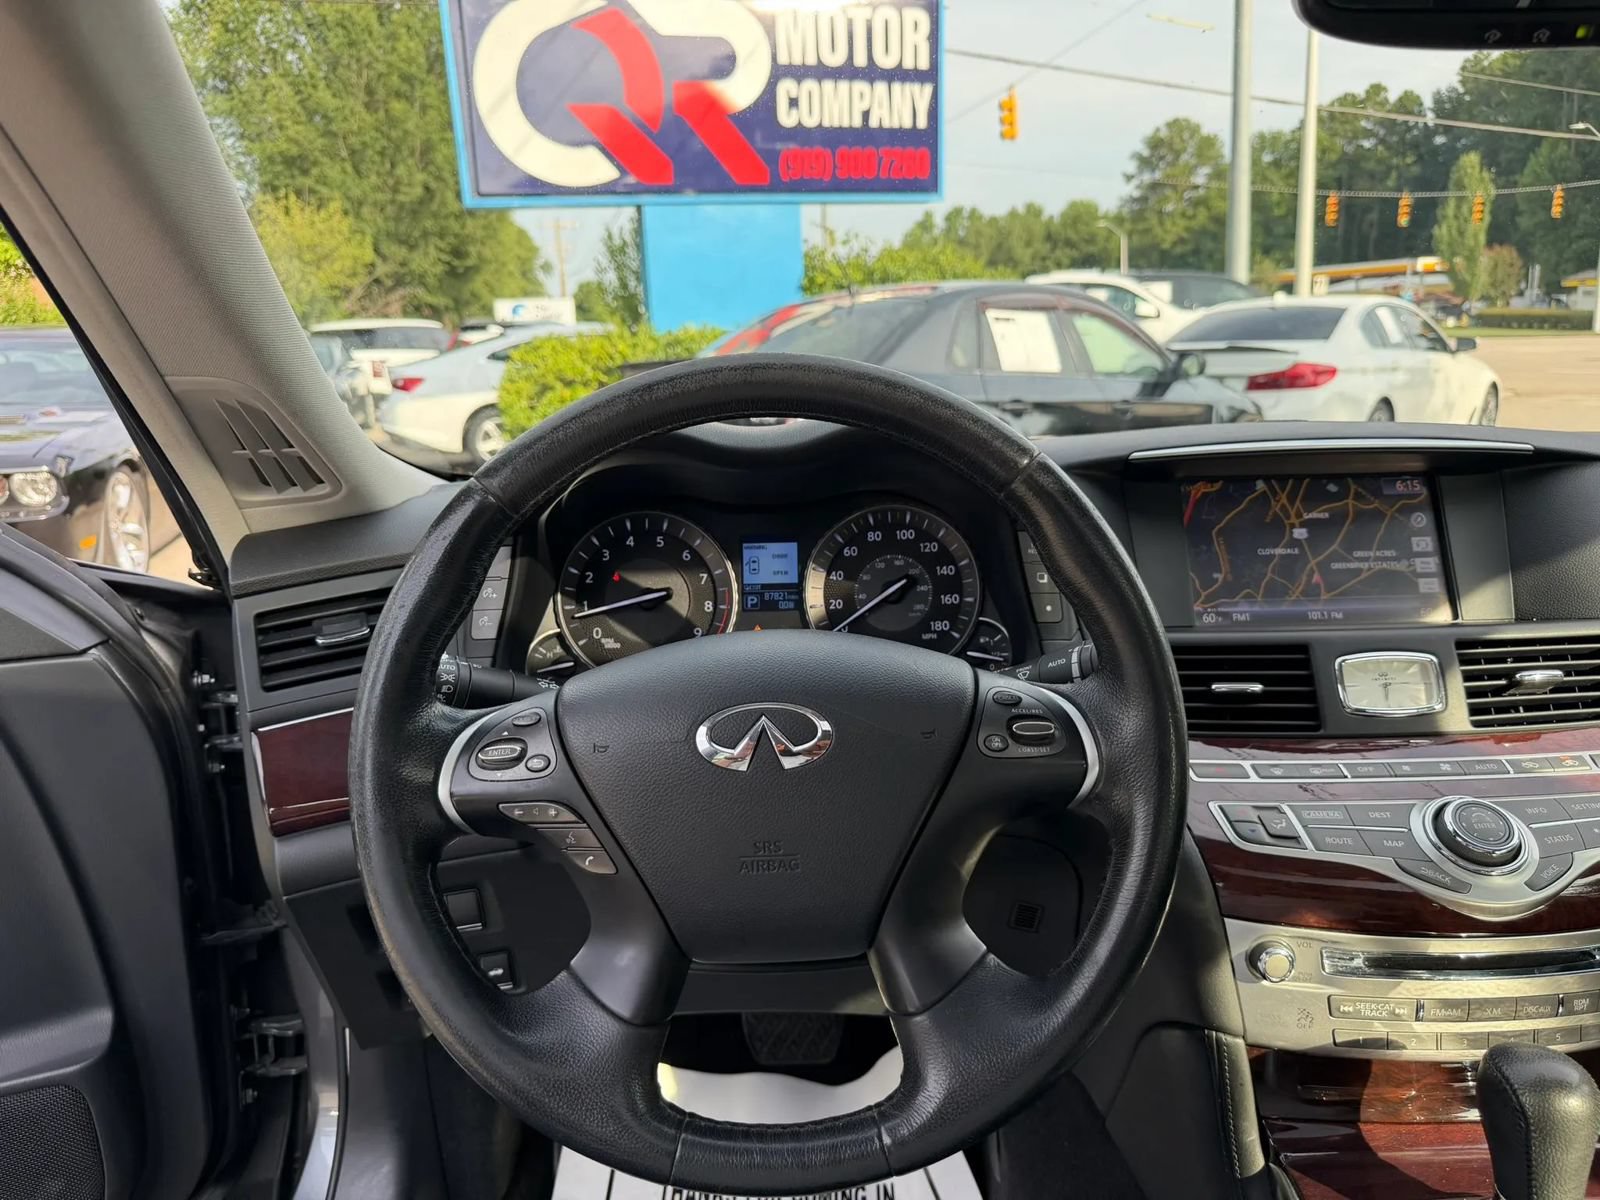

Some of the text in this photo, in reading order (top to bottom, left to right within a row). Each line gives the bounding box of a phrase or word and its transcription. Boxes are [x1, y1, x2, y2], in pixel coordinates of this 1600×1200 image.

[775, 5, 931, 70] MOTOR
[776, 78, 933, 130] COMPANY
[1395, 480, 1421, 490] 6:15
[867, 531, 882, 541] 80
[896, 529, 915, 540] 100
[626, 536, 635, 547] 4
[656, 536, 665, 547] 5
[920, 541, 938, 552] 120
[602, 550, 610, 561] 3
[682, 550, 691, 561] 6
[843, 546, 858, 556] 60
[936, 565, 955, 575] 140
[585, 572, 594, 583] 2
[699, 573, 708, 585] 7
[829, 570, 844, 581] 40
[747, 596, 757, 608] P
[940, 594, 960, 604] 160
[704, 601, 713, 612] 8
[829, 599, 843, 610] 20
[1232, 613, 1250, 622] FM1
[930, 620, 950, 631] 180
[593, 627, 602, 639] 0
[693, 627, 702, 637] 9
[1047, 658, 1067, 668] AUTO
[487, 749, 511, 757] ENTER
[1475, 763, 1498, 771] AUTO
[1525, 807, 1548, 815] INFO
[1474, 822, 1497, 830] ENTER
[1325, 836, 1353, 845] ROUTE
[1383, 839, 1405, 847] MAP
[1544, 834, 1575, 844] STATUS
[753, 840, 783, 854] SRS
[740, 860, 800, 874] AIRBAG
[1360, 1009, 1388, 1017] TRACK
[1555, 1032, 1561, 1041] 5
[1462, 1038, 1468, 1046] 3
